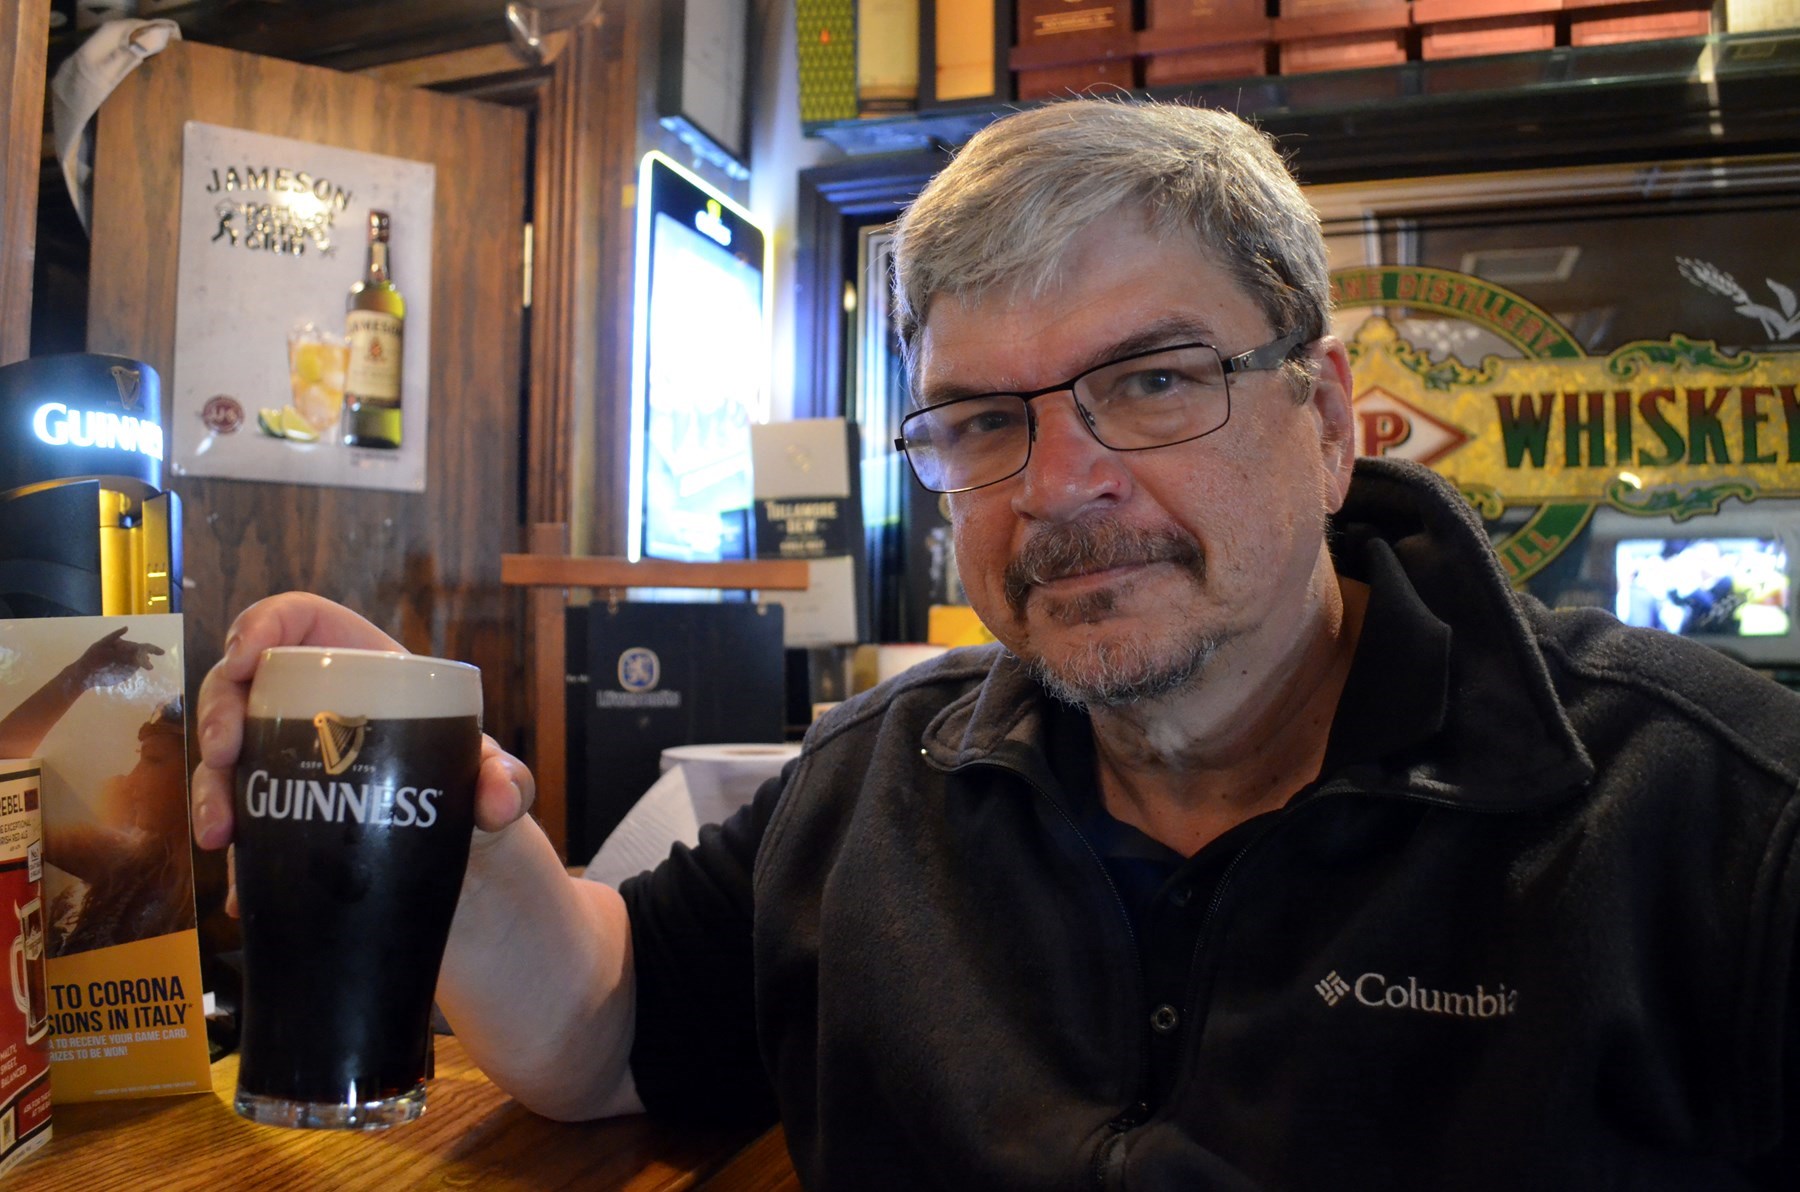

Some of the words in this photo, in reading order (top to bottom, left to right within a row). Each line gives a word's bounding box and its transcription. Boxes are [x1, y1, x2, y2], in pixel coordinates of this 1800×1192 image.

[206, 165, 352, 211] JAMESON
[1398, 274, 1560, 347] DISTILLERY
[1494, 383, 1800, 468] WHISKEY
[0, 793, 23, 816] EBEL
[246, 769, 438, 828] GUINNESS
[51, 984, 82, 1010] TO
[88, 975, 185, 1008] CORONA
[107, 1008, 129, 1031] IN
[56, 1038, 68, 1048] TO
[69, 1034, 107, 1048] RECEIVE
[109, 1032, 133, 1045] YOUR
[135, 1030, 160, 1042] GAME
[77, 1049, 88, 1060] TO
[90, 1048, 101, 1058] BE
[103, 1045, 128, 1058] WON!
[1, 1064, 27, 1089] BALANCED
